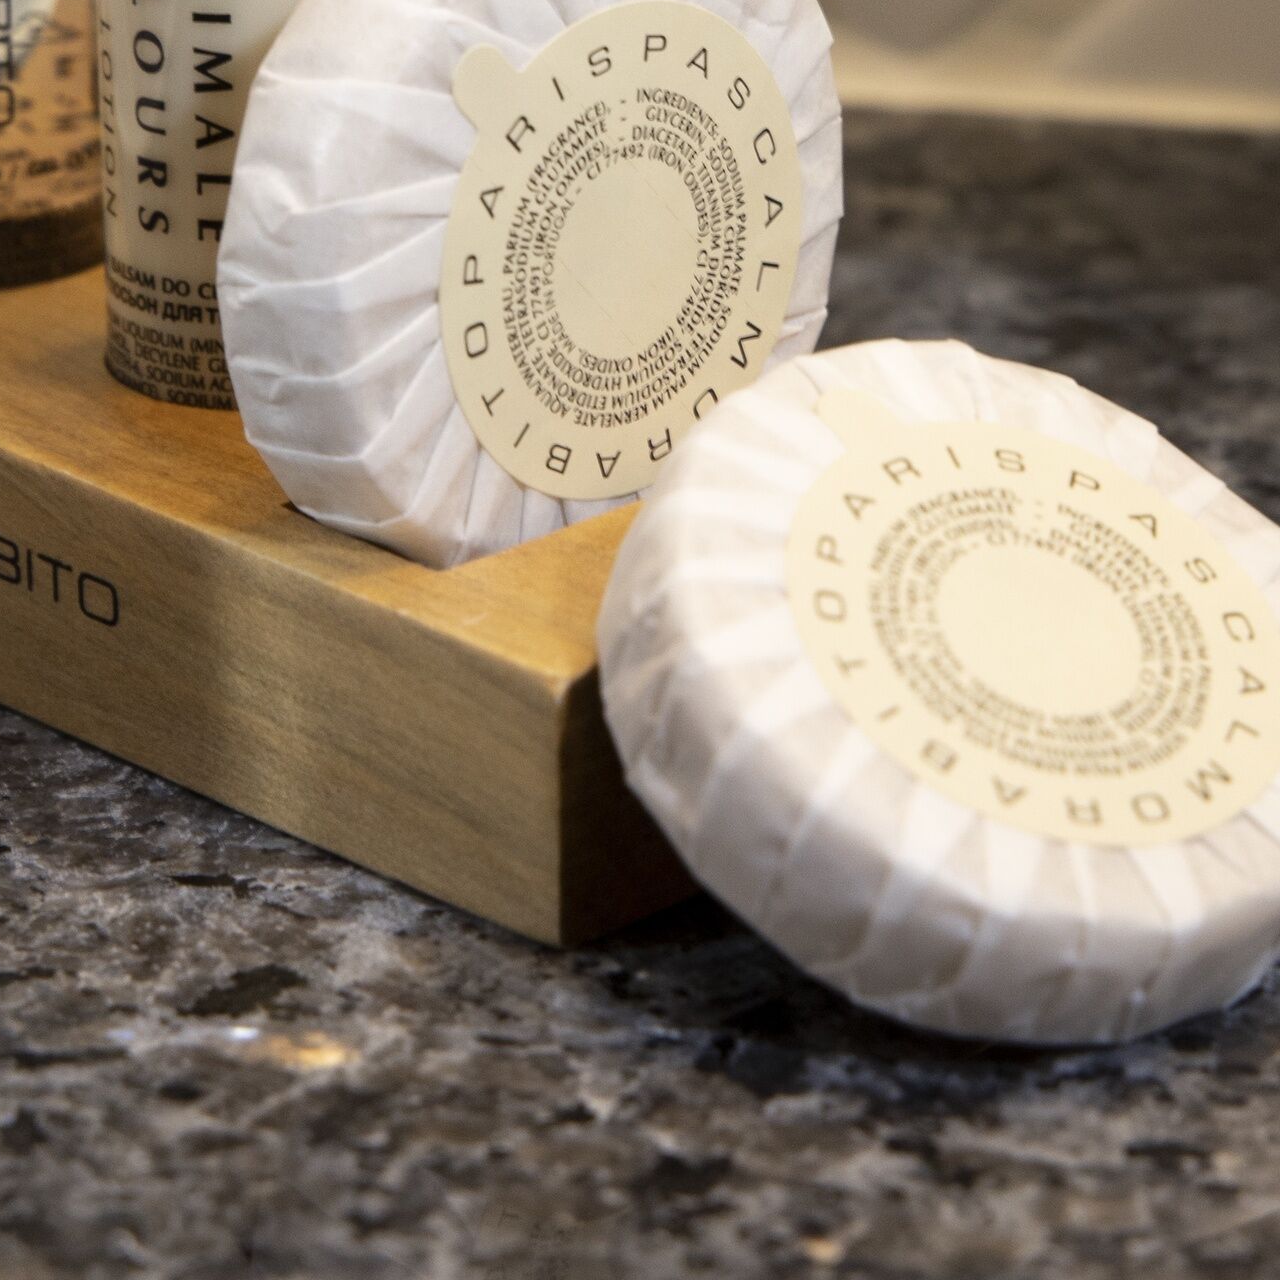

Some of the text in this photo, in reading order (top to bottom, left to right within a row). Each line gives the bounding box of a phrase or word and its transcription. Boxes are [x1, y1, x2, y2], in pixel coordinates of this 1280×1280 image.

[99, 17, 118, 217] LOTION
[636, 87, 723, 140] INGREDIENTS:
[463, 45, 612, 285] PARIS
[533, 113, 607, 207] GLUTAMATE
[643, 34, 783, 292] PASCAL
[704, 146, 734, 221] SODIUM
[716, 135, 746, 208] SODIUM
[502, 195, 531, 274] PARFUM
[542, 193, 575, 287] PORTUGAL
[694, 160, 721, 249] TITANIUM
[162, 277, 191, 297] DO
[514, 208, 539, 350] TETRASODIUM
[723, 211, 748, 301] PALMATE,
[543, 289, 556, 312] IN
[547, 309, 576, 357] MADE
[686, 304, 733, 378] SODIUM
[611, 329, 708, 410] TETRASODIUM
[626, 338, 683, 387] SODIUM
[651, 373, 688, 411] PALM
[816, 445, 1026, 565] PARIS
[1069, 470, 1265, 743] PASCAL
[813, 589, 1234, 826] MORABITO
